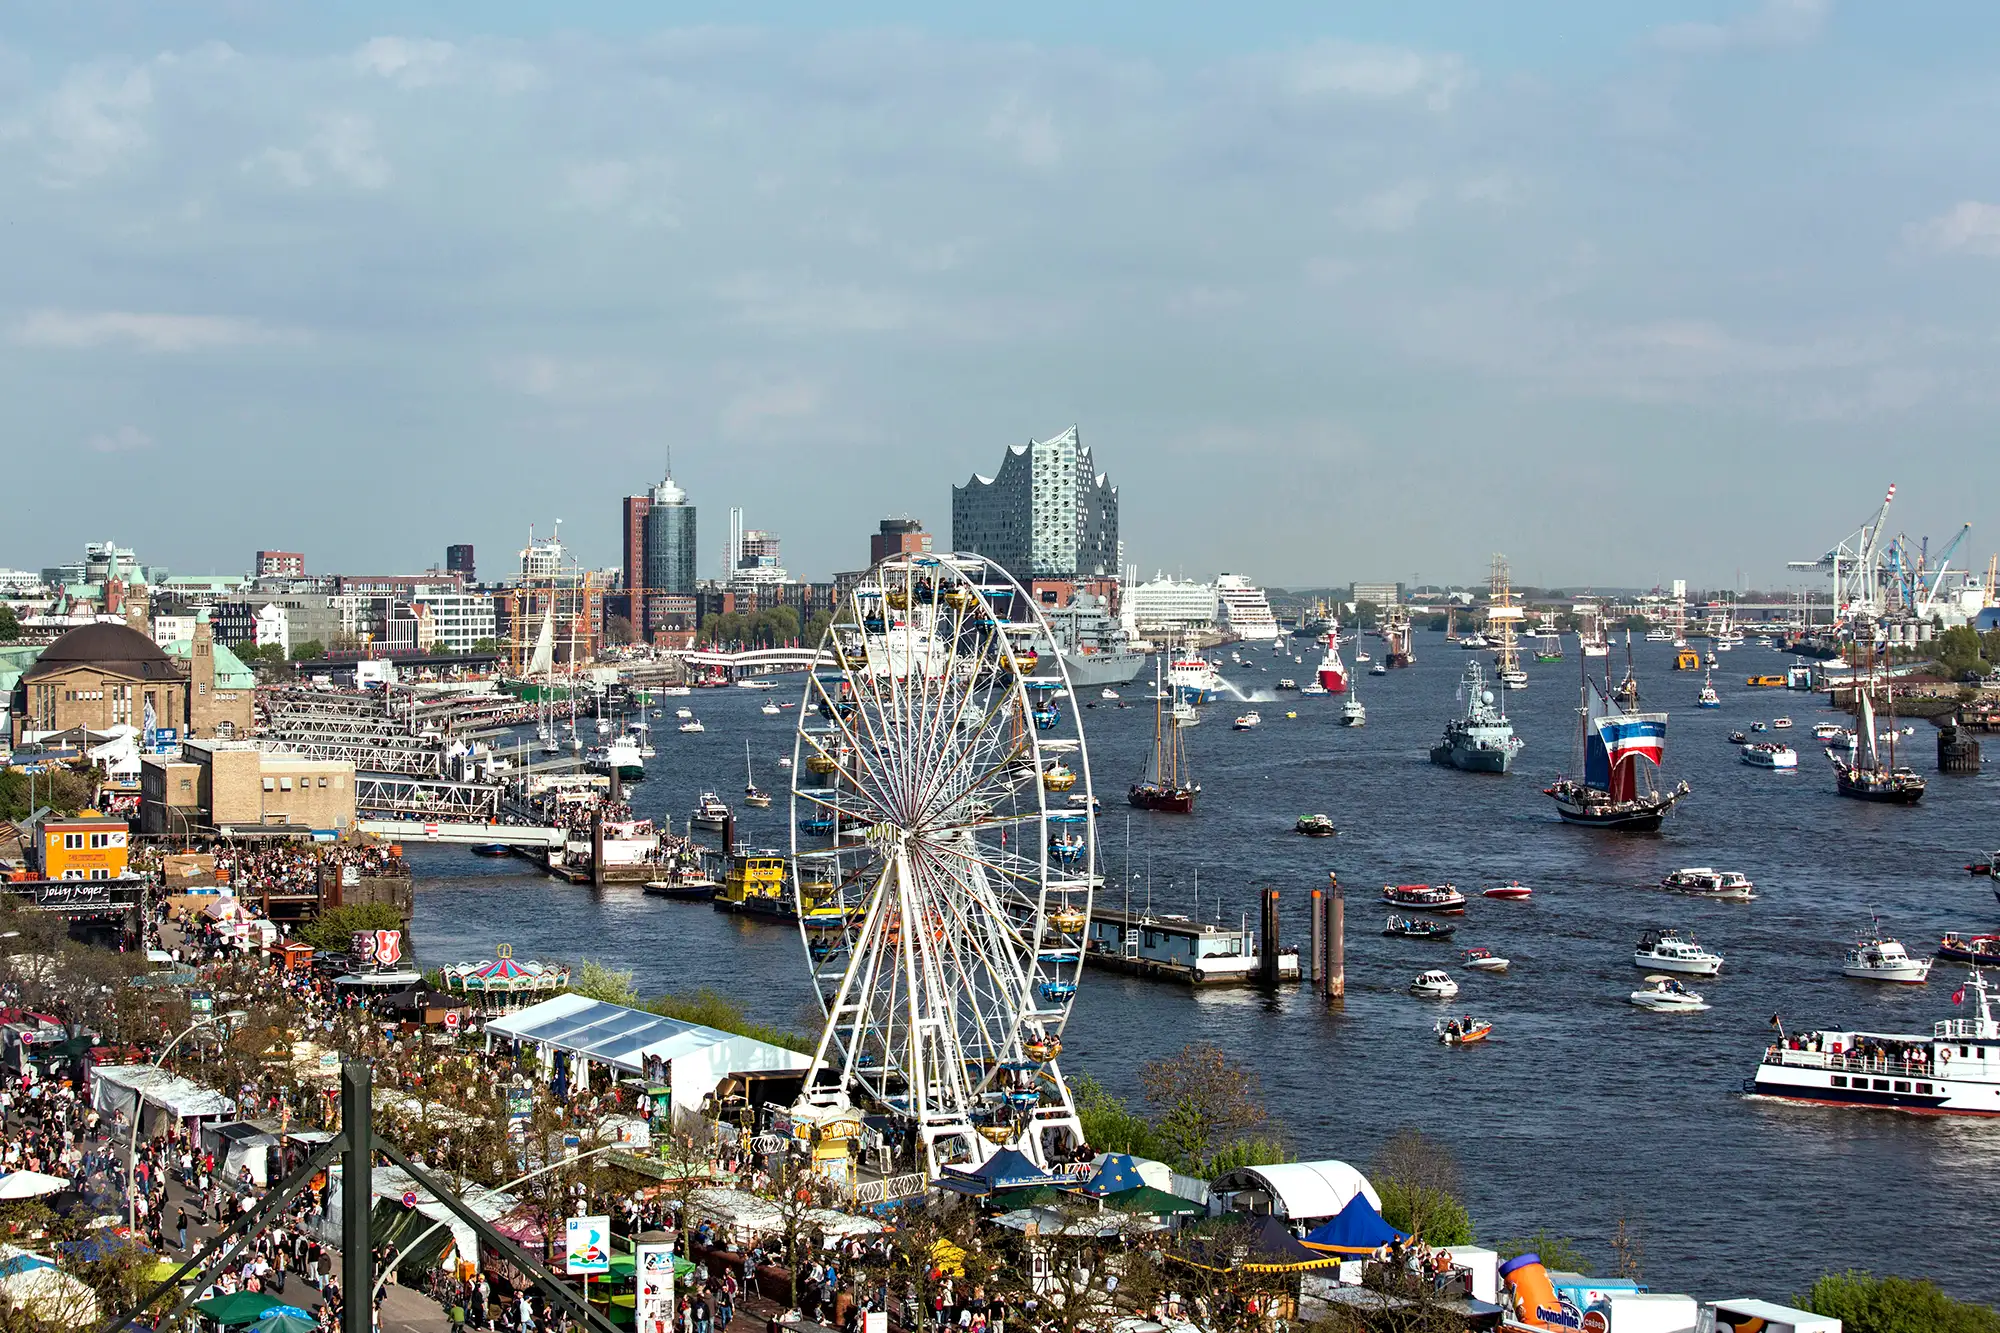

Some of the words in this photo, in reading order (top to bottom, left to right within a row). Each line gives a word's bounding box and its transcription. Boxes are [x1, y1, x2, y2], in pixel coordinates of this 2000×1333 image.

[51, 834, 60, 847] P
[865, 821, 902, 845] MOVIE
[41, 884, 71, 902] Jolly
[73, 884, 105, 902] Roger
[1536, 1304, 1580, 1330] Ovomaltine
